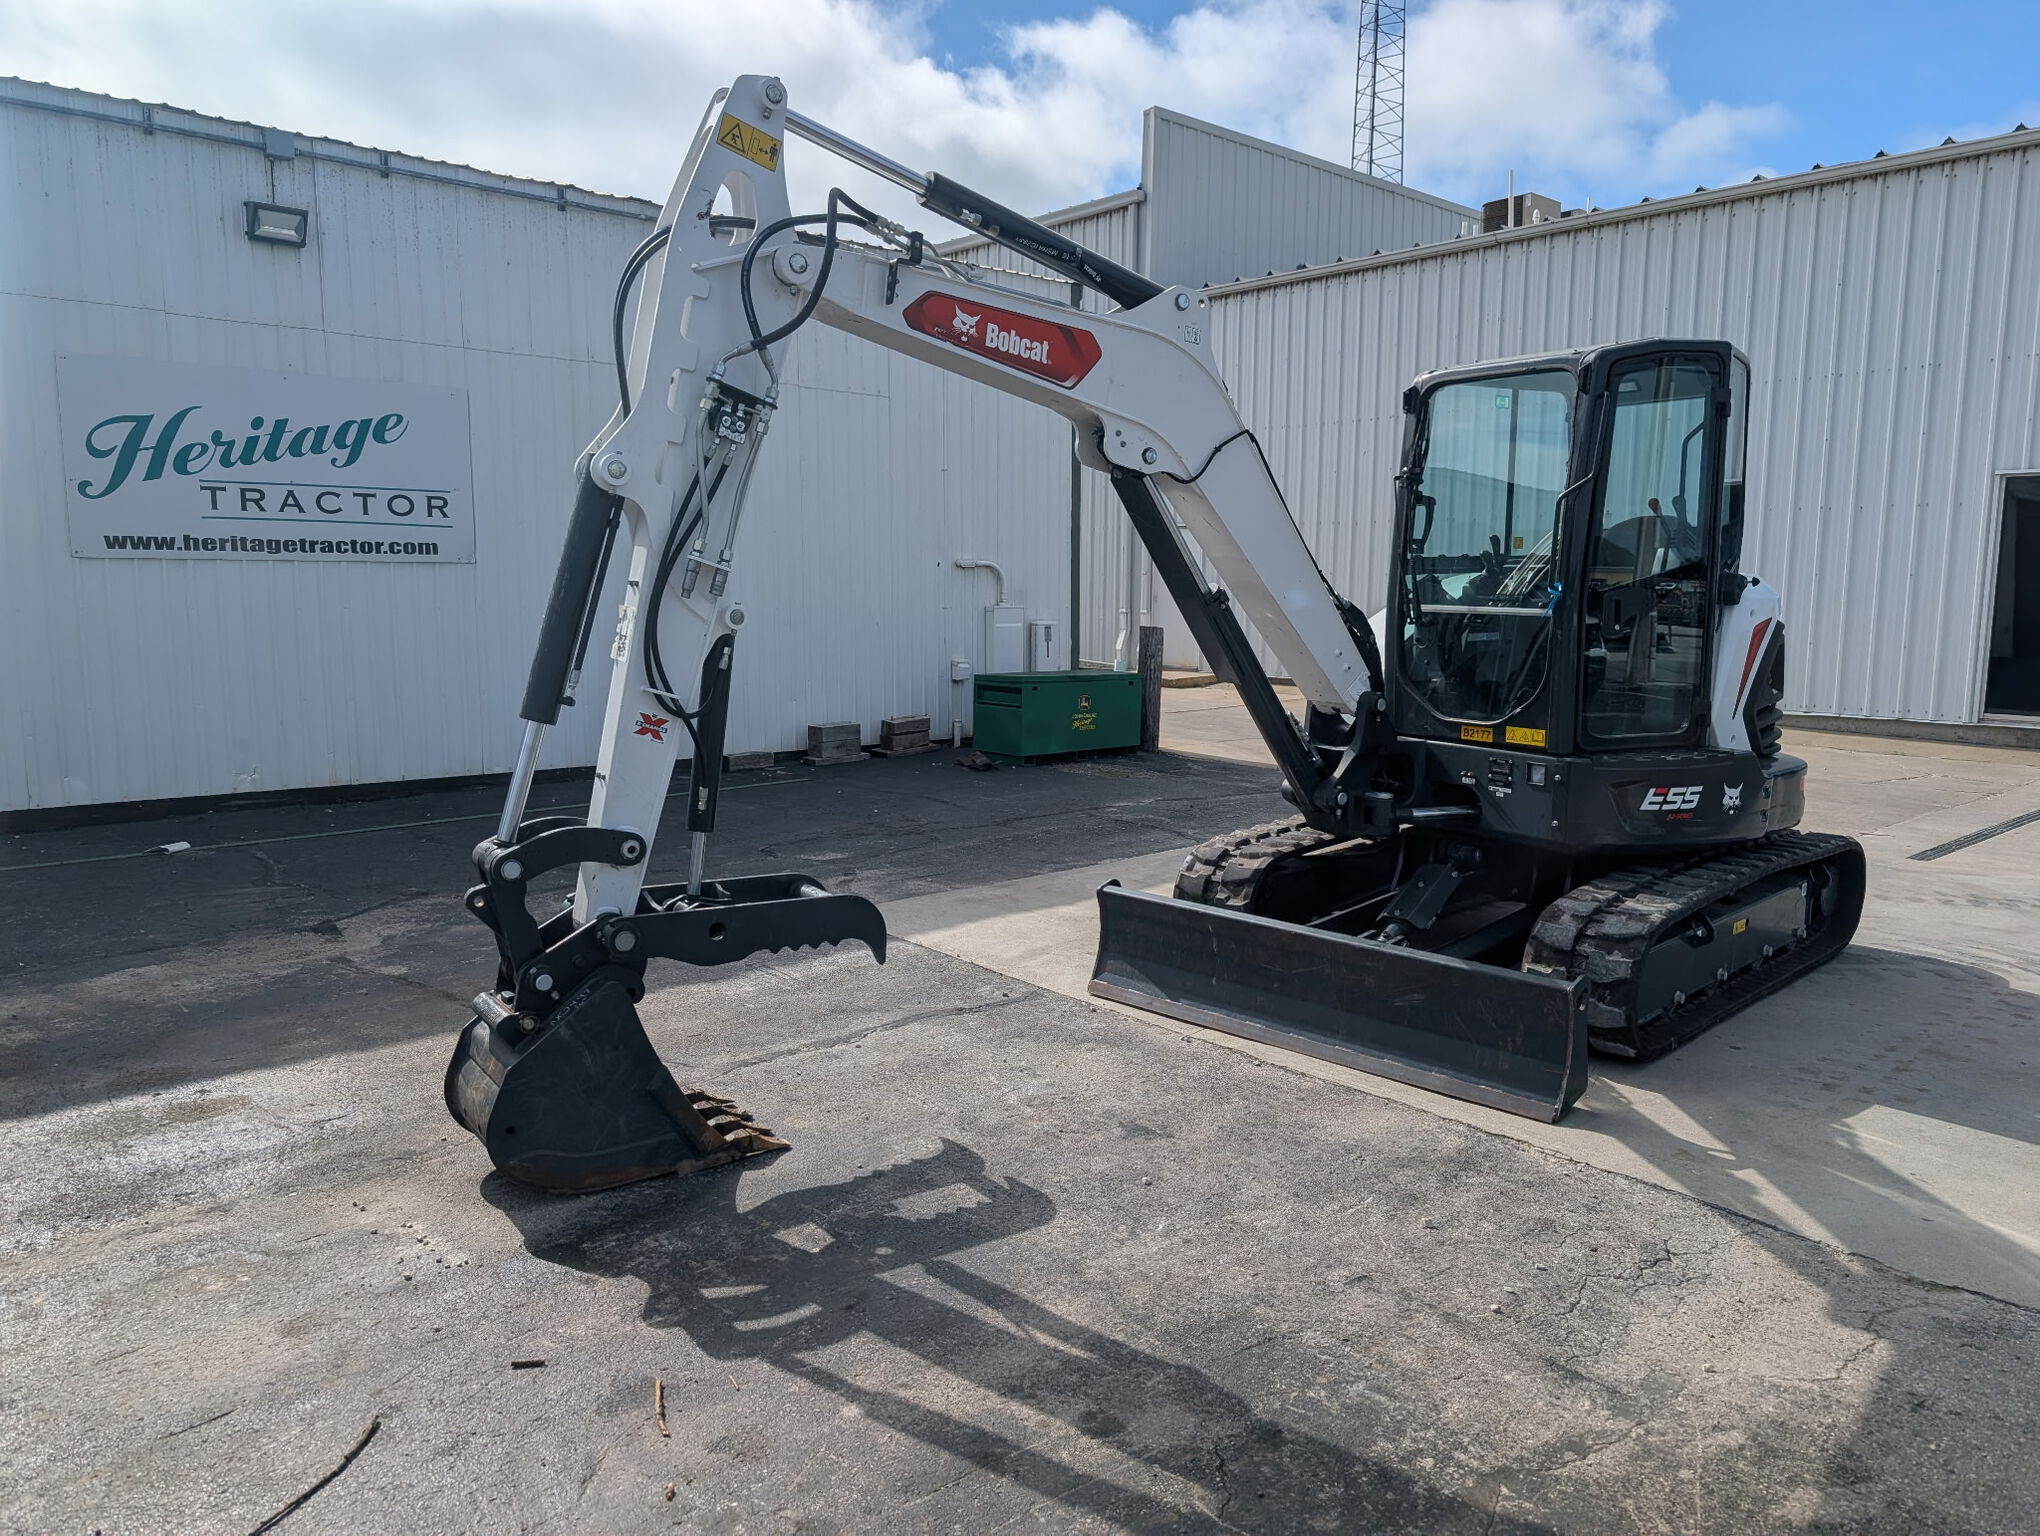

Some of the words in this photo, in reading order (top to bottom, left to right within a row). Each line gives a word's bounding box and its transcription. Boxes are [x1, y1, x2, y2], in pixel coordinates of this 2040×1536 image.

[985, 322, 1050, 365] Bobcat
[77, 405, 410, 500] Heritage
[200, 485, 451, 519] TRACTOR
[103, 534, 439, 556] www.heritagetractor.com
[1462, 727, 1491, 740] B2177
[1639, 785, 1704, 811] E55
